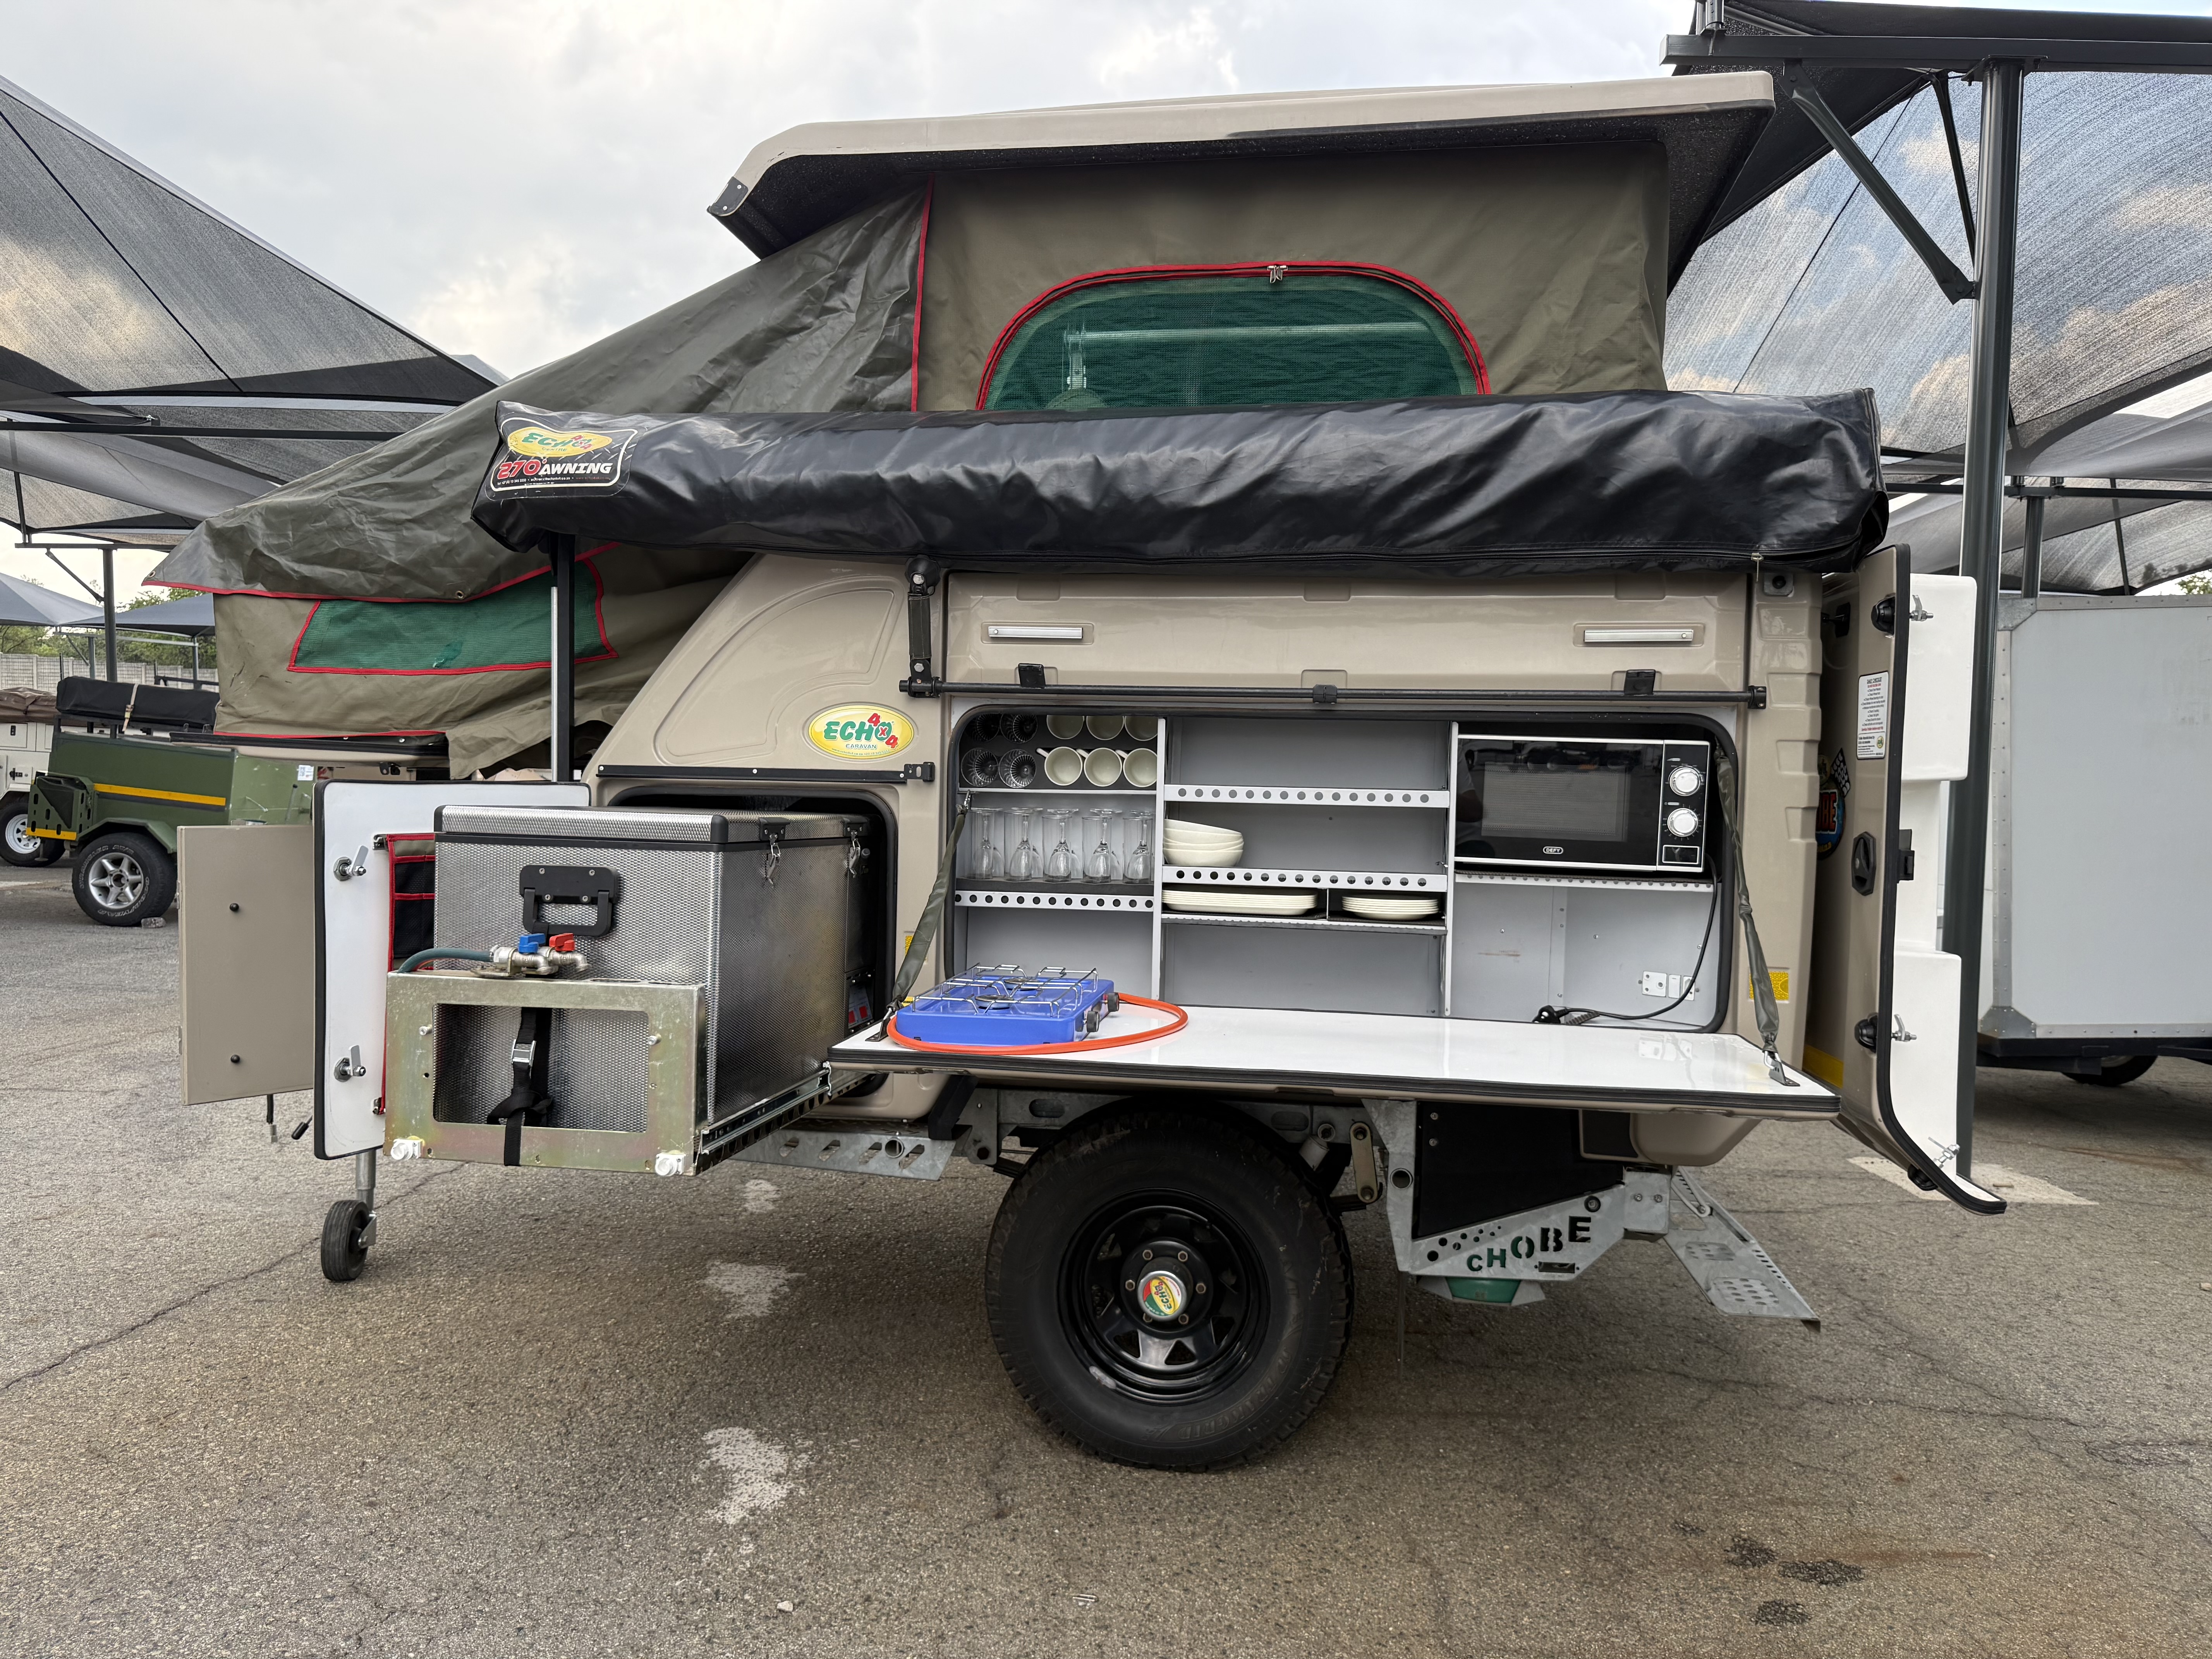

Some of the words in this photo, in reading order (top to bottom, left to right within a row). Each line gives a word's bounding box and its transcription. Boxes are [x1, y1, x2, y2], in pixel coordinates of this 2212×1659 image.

[538, 463, 613, 476] AWNING
[824, 721, 892, 741] ECHO
[1467, 1215, 1592, 1272] CHOBE
